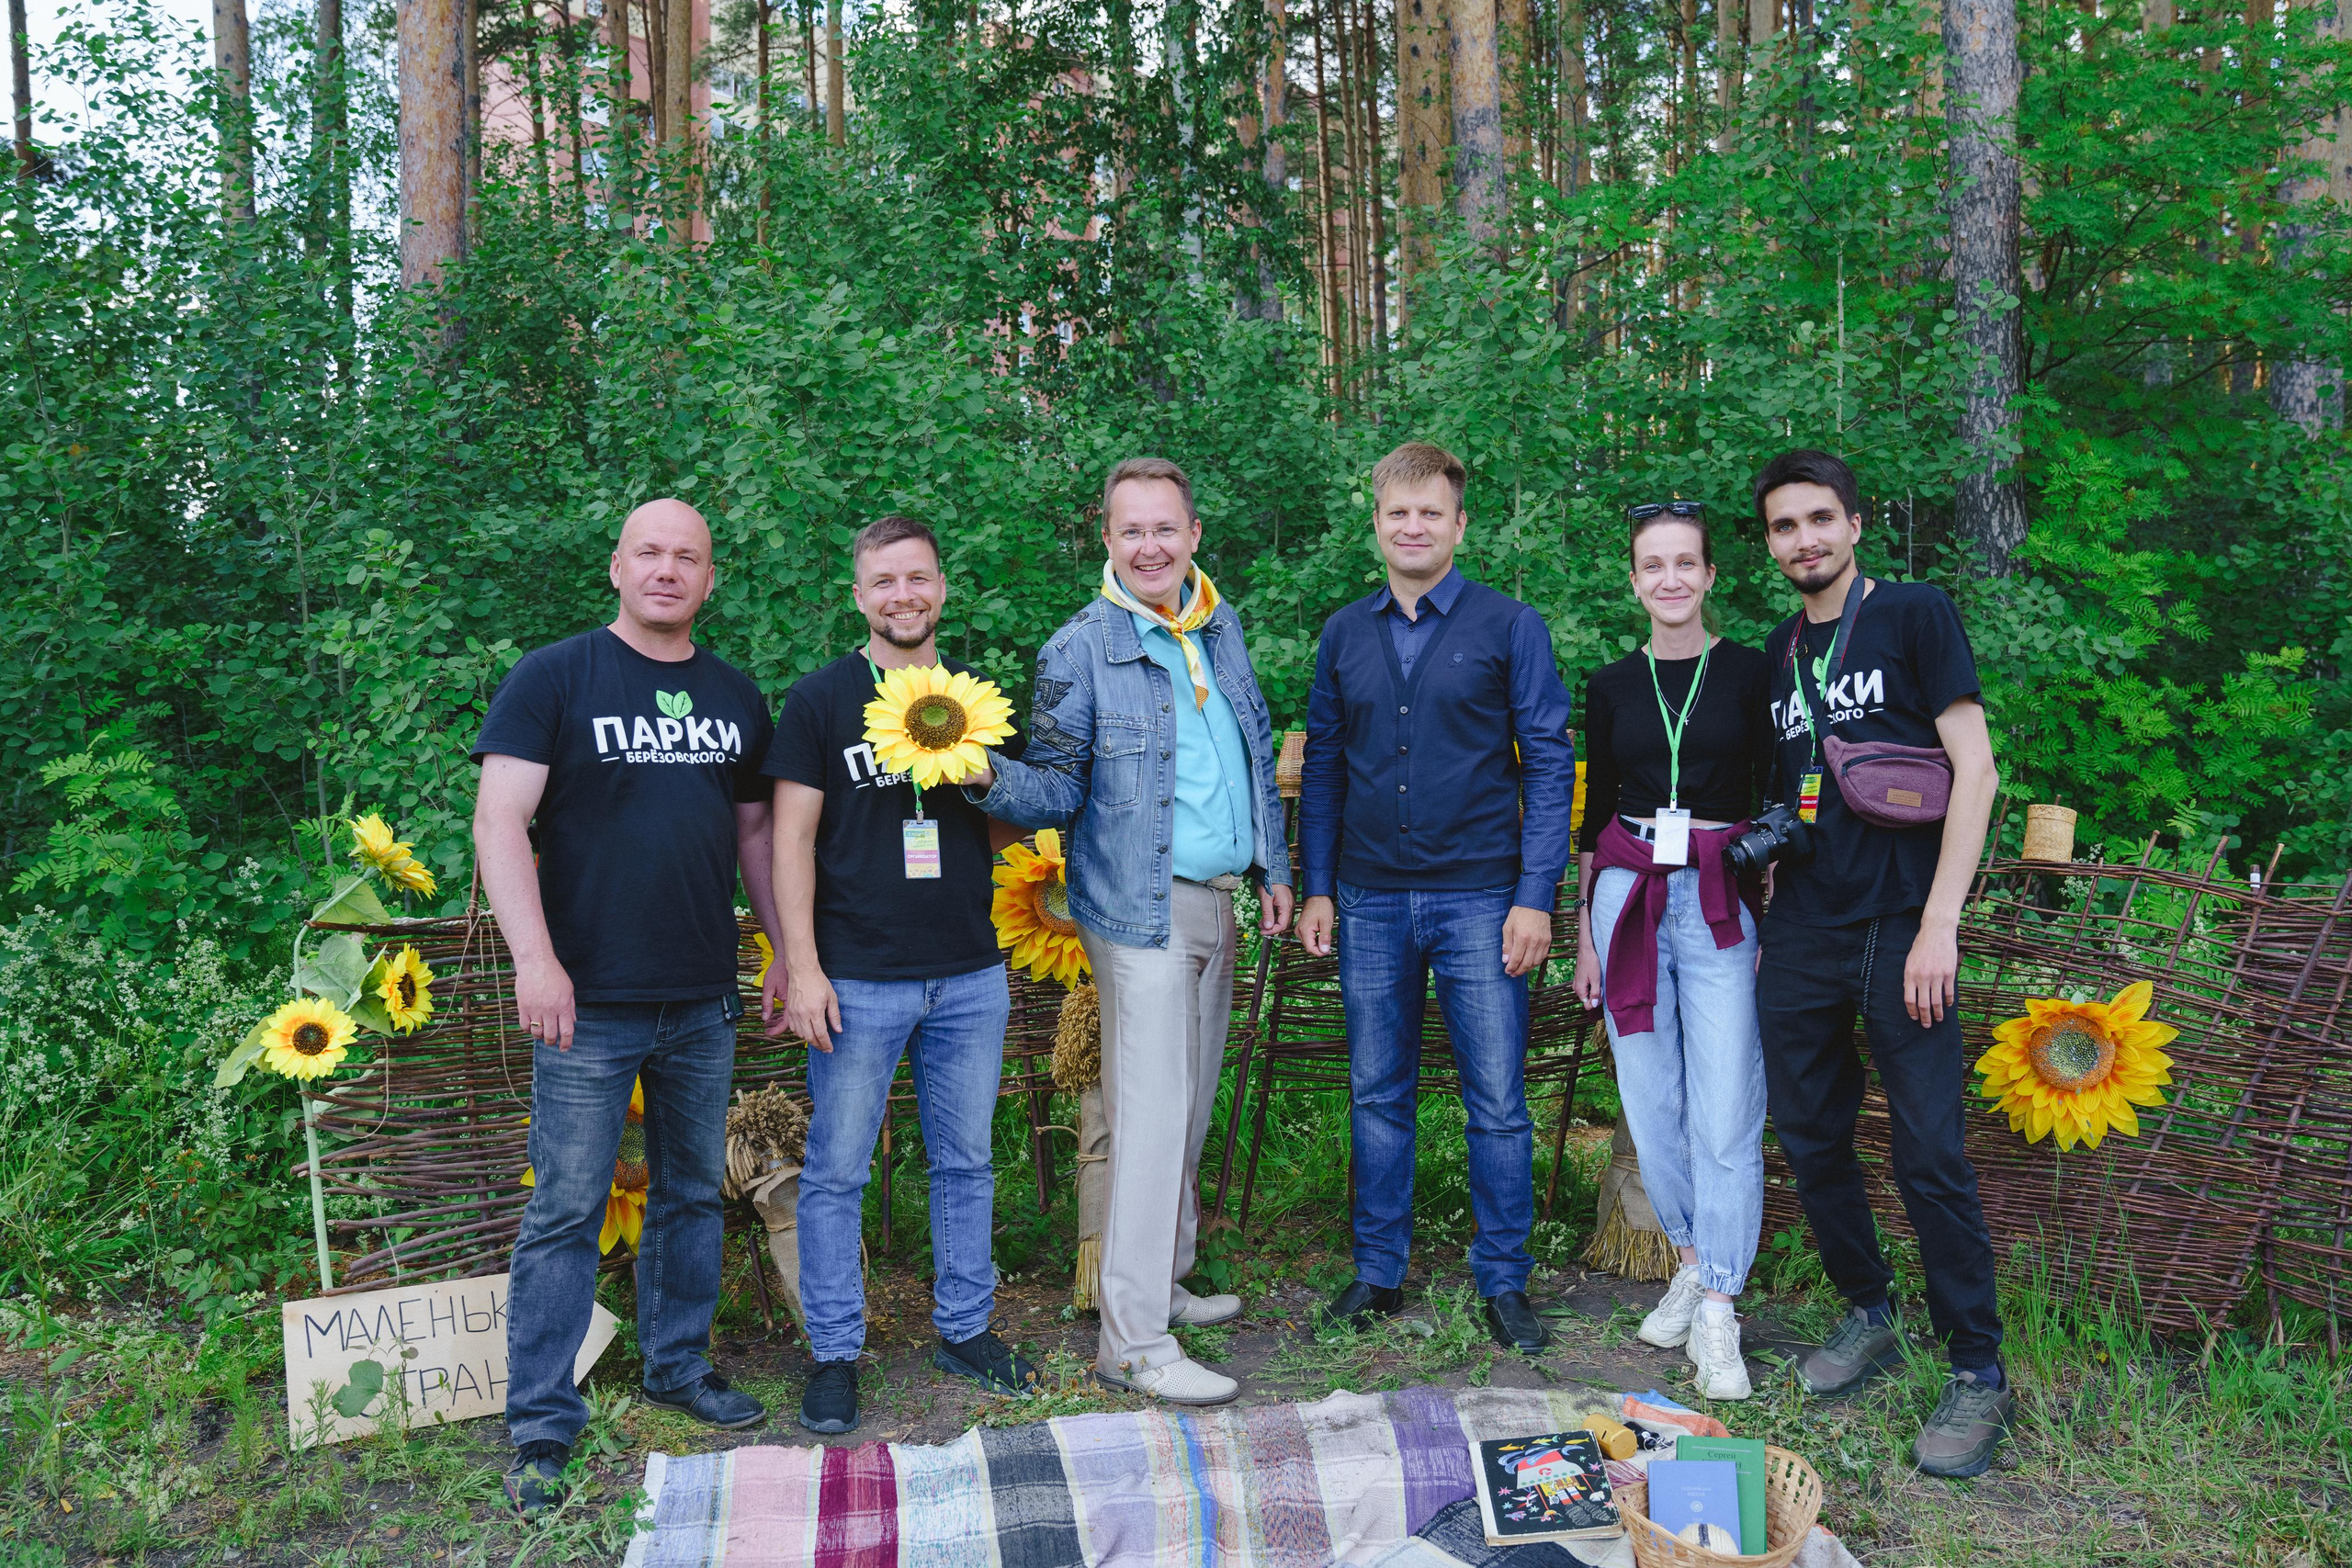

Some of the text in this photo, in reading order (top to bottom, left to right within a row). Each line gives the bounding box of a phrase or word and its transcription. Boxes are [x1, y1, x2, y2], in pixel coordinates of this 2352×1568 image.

[593, 716, 741, 754] ПАРКИ
[626, 749, 726, 764] БЕРЁЗОВСКОГО
[358, 1357, 509, 1417] ТРАН
[1707, 1450, 1736, 1460] Сергей
